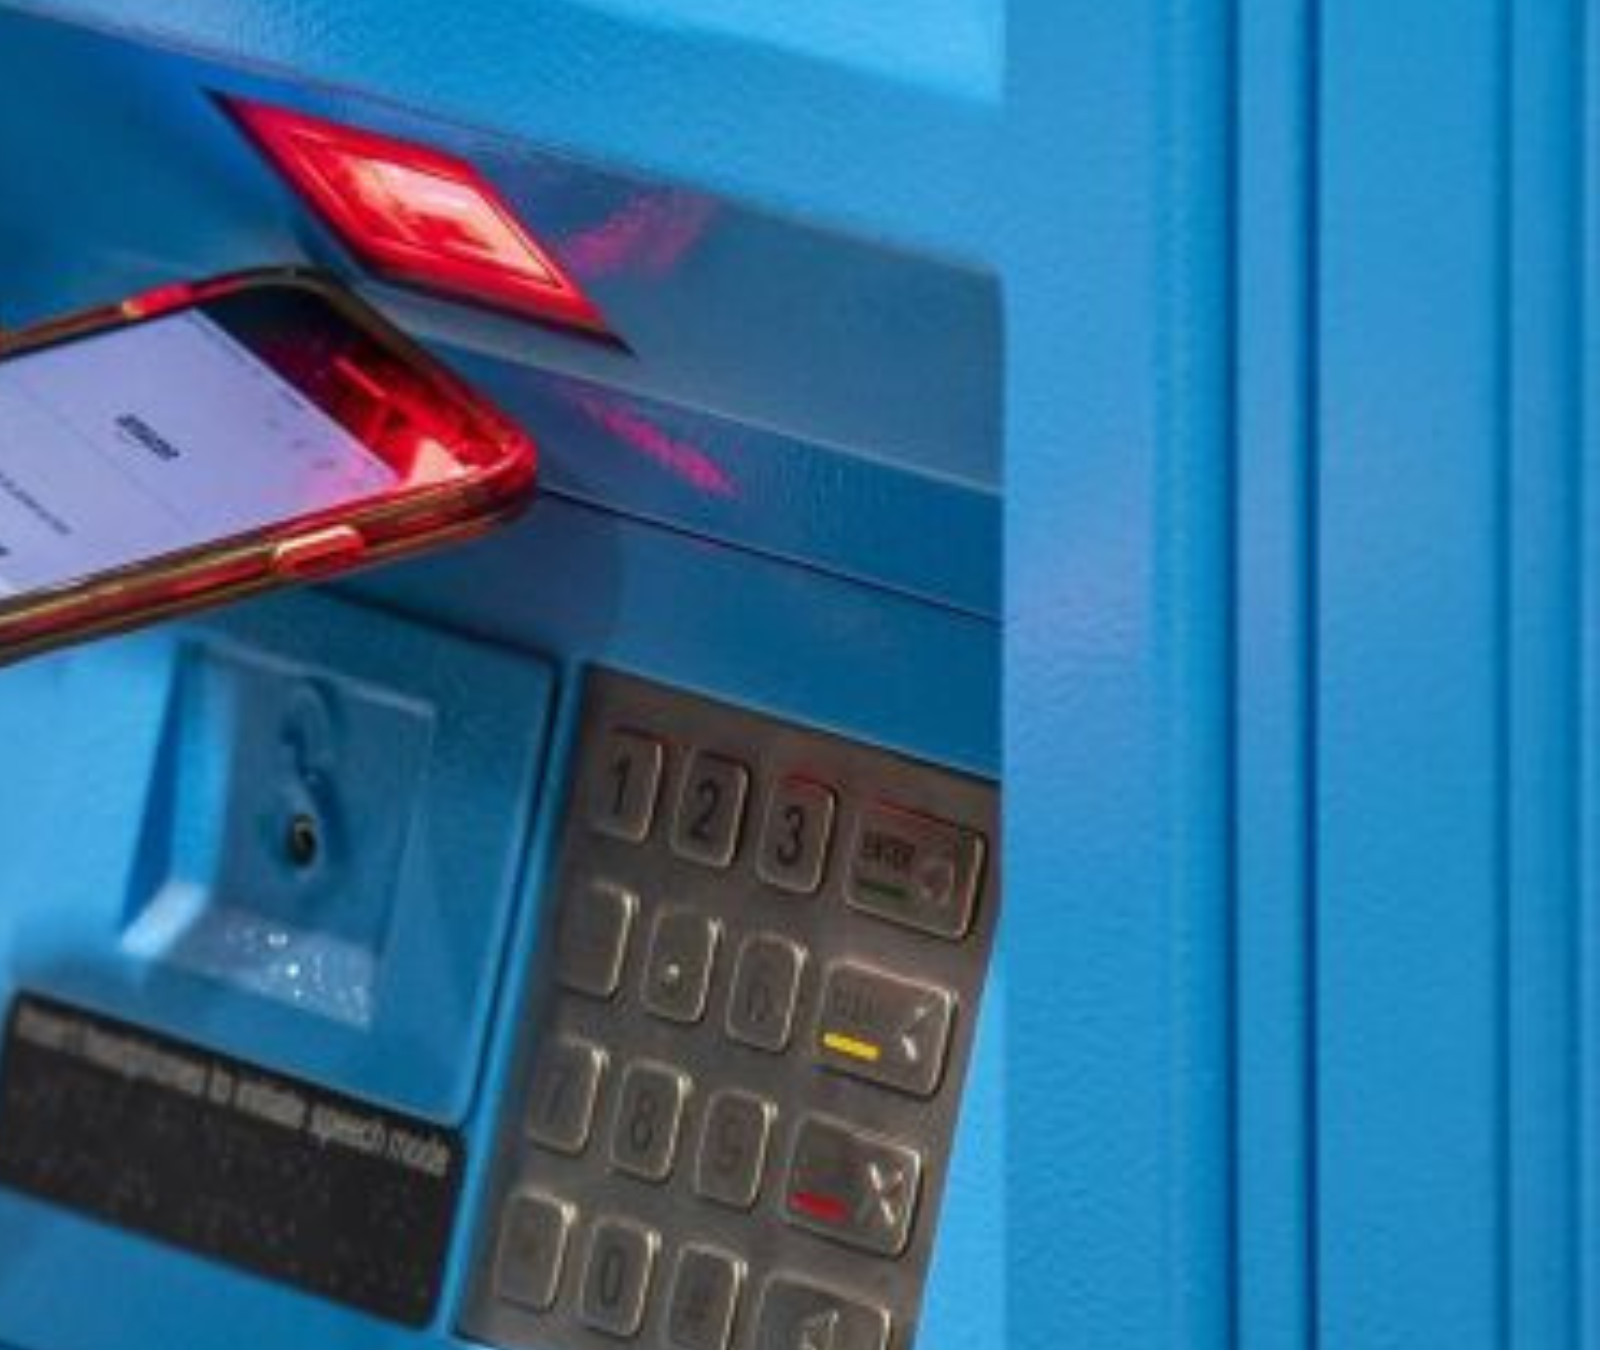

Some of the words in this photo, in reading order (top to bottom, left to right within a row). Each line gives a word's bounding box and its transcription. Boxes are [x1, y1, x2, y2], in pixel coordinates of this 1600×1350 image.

[611, 753, 633, 811] 1
[687, 779, 718, 842] 2
[776, 803, 805, 867] 3
[310, 1105, 384, 1154] speech
[386, 1124, 450, 1177] mode
[630, 1089, 656, 1152] 8
[599, 1245, 627, 1307] 0
